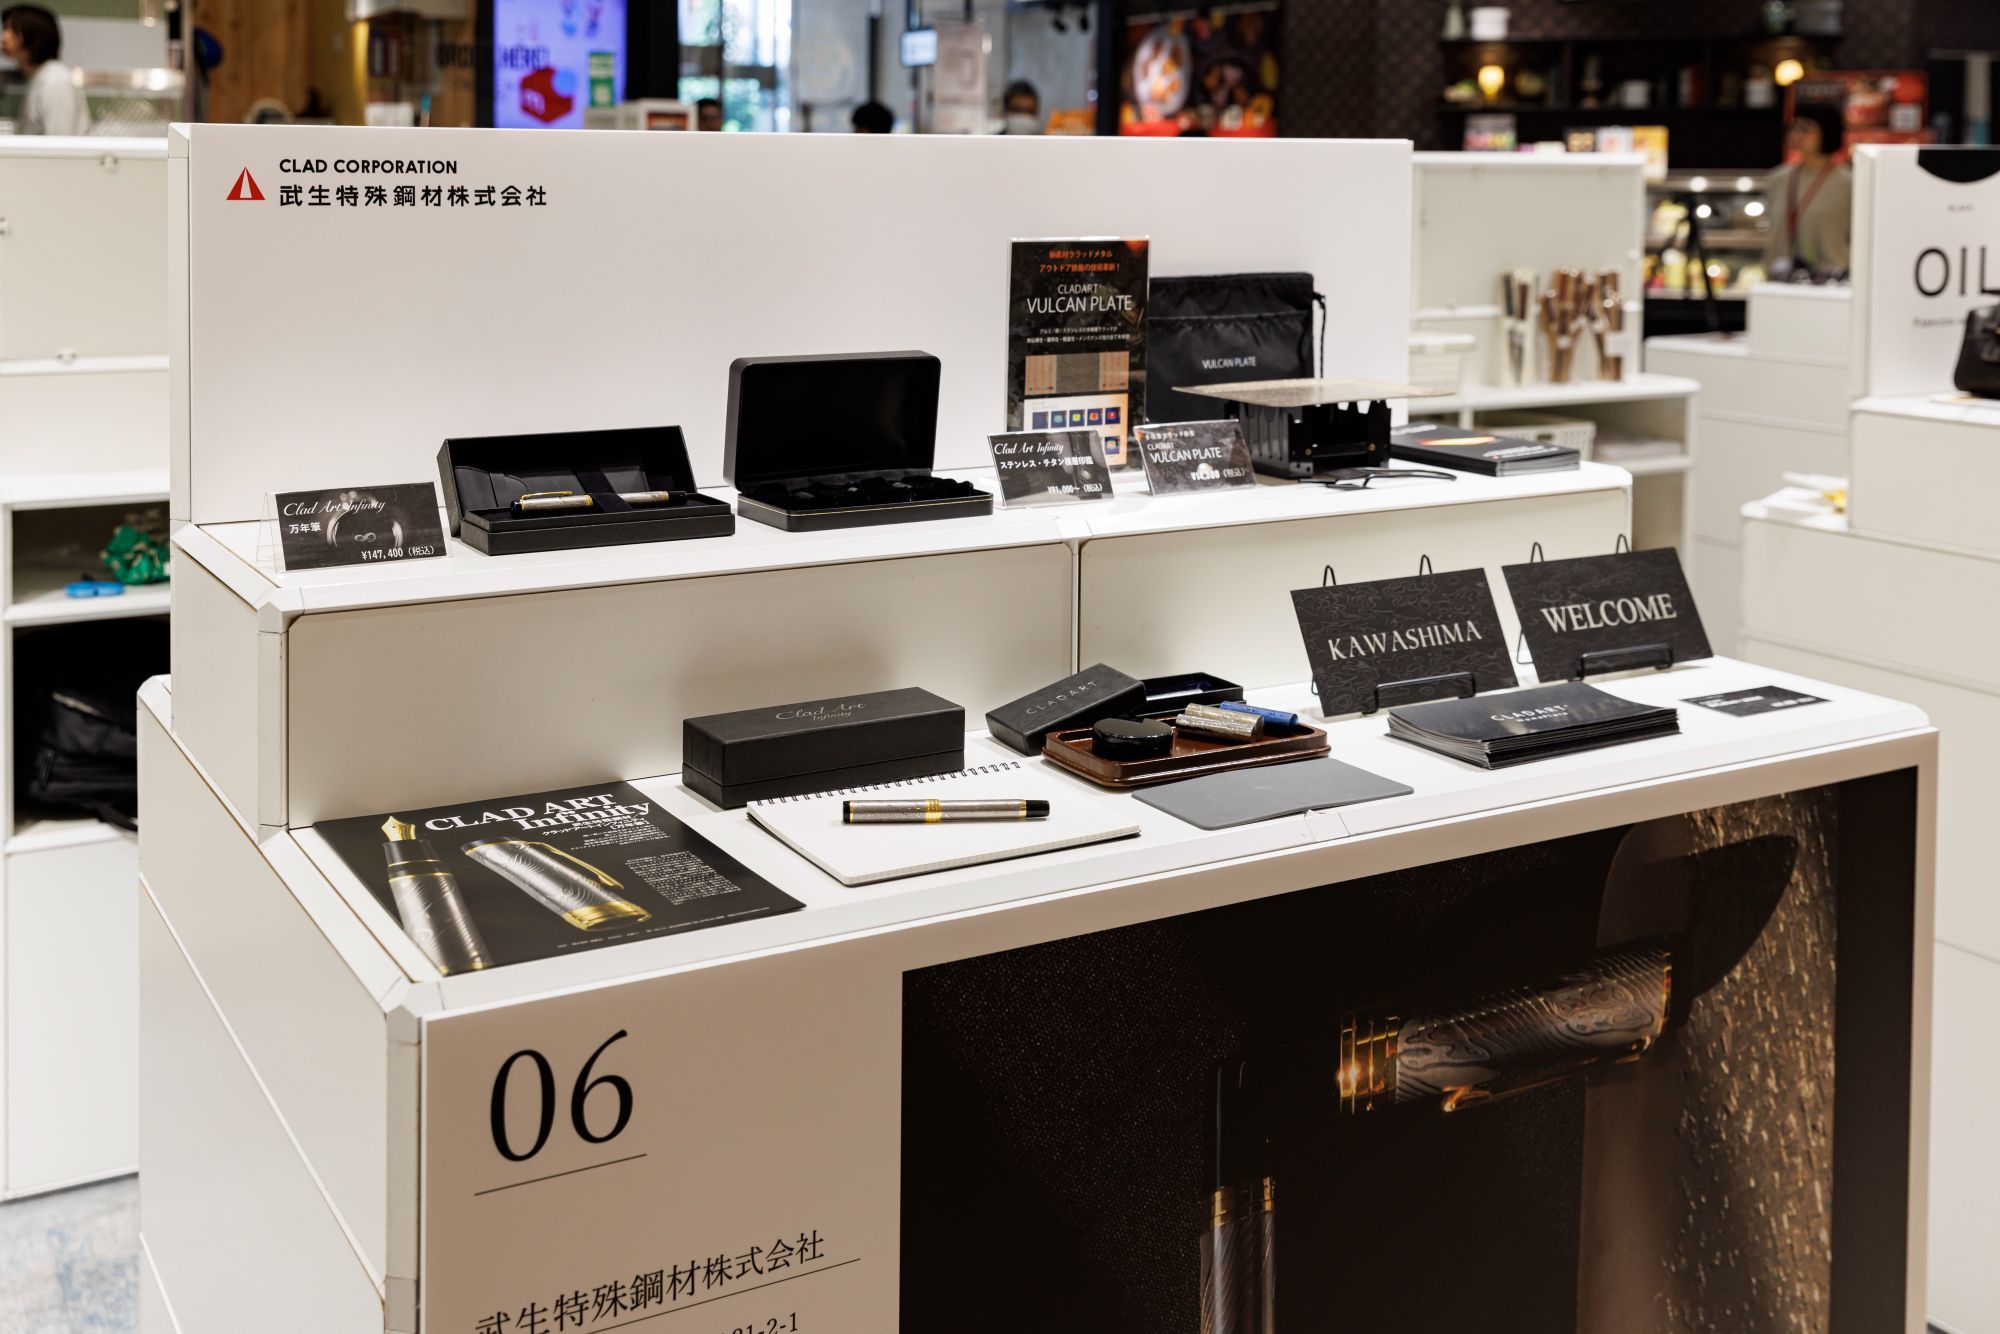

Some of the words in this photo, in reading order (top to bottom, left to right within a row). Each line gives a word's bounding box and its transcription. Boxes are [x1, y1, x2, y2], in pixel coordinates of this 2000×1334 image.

[279, 159, 327, 173] CLAD
[333, 159, 458, 174] CORPORATION
[279, 184, 547, 207] 武生特殊鋼材株式会社
[1057, 284, 1098, 294] CLADART
[1026, 297, 1087, 313] VULCAN
[1090, 295, 1133, 312] PLATE
[1201, 357, 1234, 369] VULCAN
[1234, 356, 1257, 367] PLATE
[994, 443, 1017, 455] Clad
[1018, 442, 1034, 454] Art
[1036, 441, 1064, 455] Infinity
[1150, 449, 1192, 464] VULCAN
[1192, 447, 1222, 460] PLATE
[283, 501, 317, 516] Clad
[318, 500, 341, 514] Art
[347, 499, 386, 515] Infinity
[288, 521, 322, 535] 万年筆
[361, 547, 404, 561] ¥147,400
[1540, 593, 1677, 634] WELCOME
[1327, 620, 1483, 661] KAWASHIMA
[1026, 680, 1097, 715] CLADART
[775, 706, 825, 720] Clad
[831, 702, 866, 713] Art
[812, 711, 851, 721] Infinity
[1490, 704, 1566, 721] CLADART
[424, 807, 535, 831] CLAD
[543, 793, 617, 815] ART
[511, 803, 650, 831] Infinity
[489, 1028, 635, 1163] 06
[474, 1229, 825, 1334] 武生特殊鋼材株式会社
